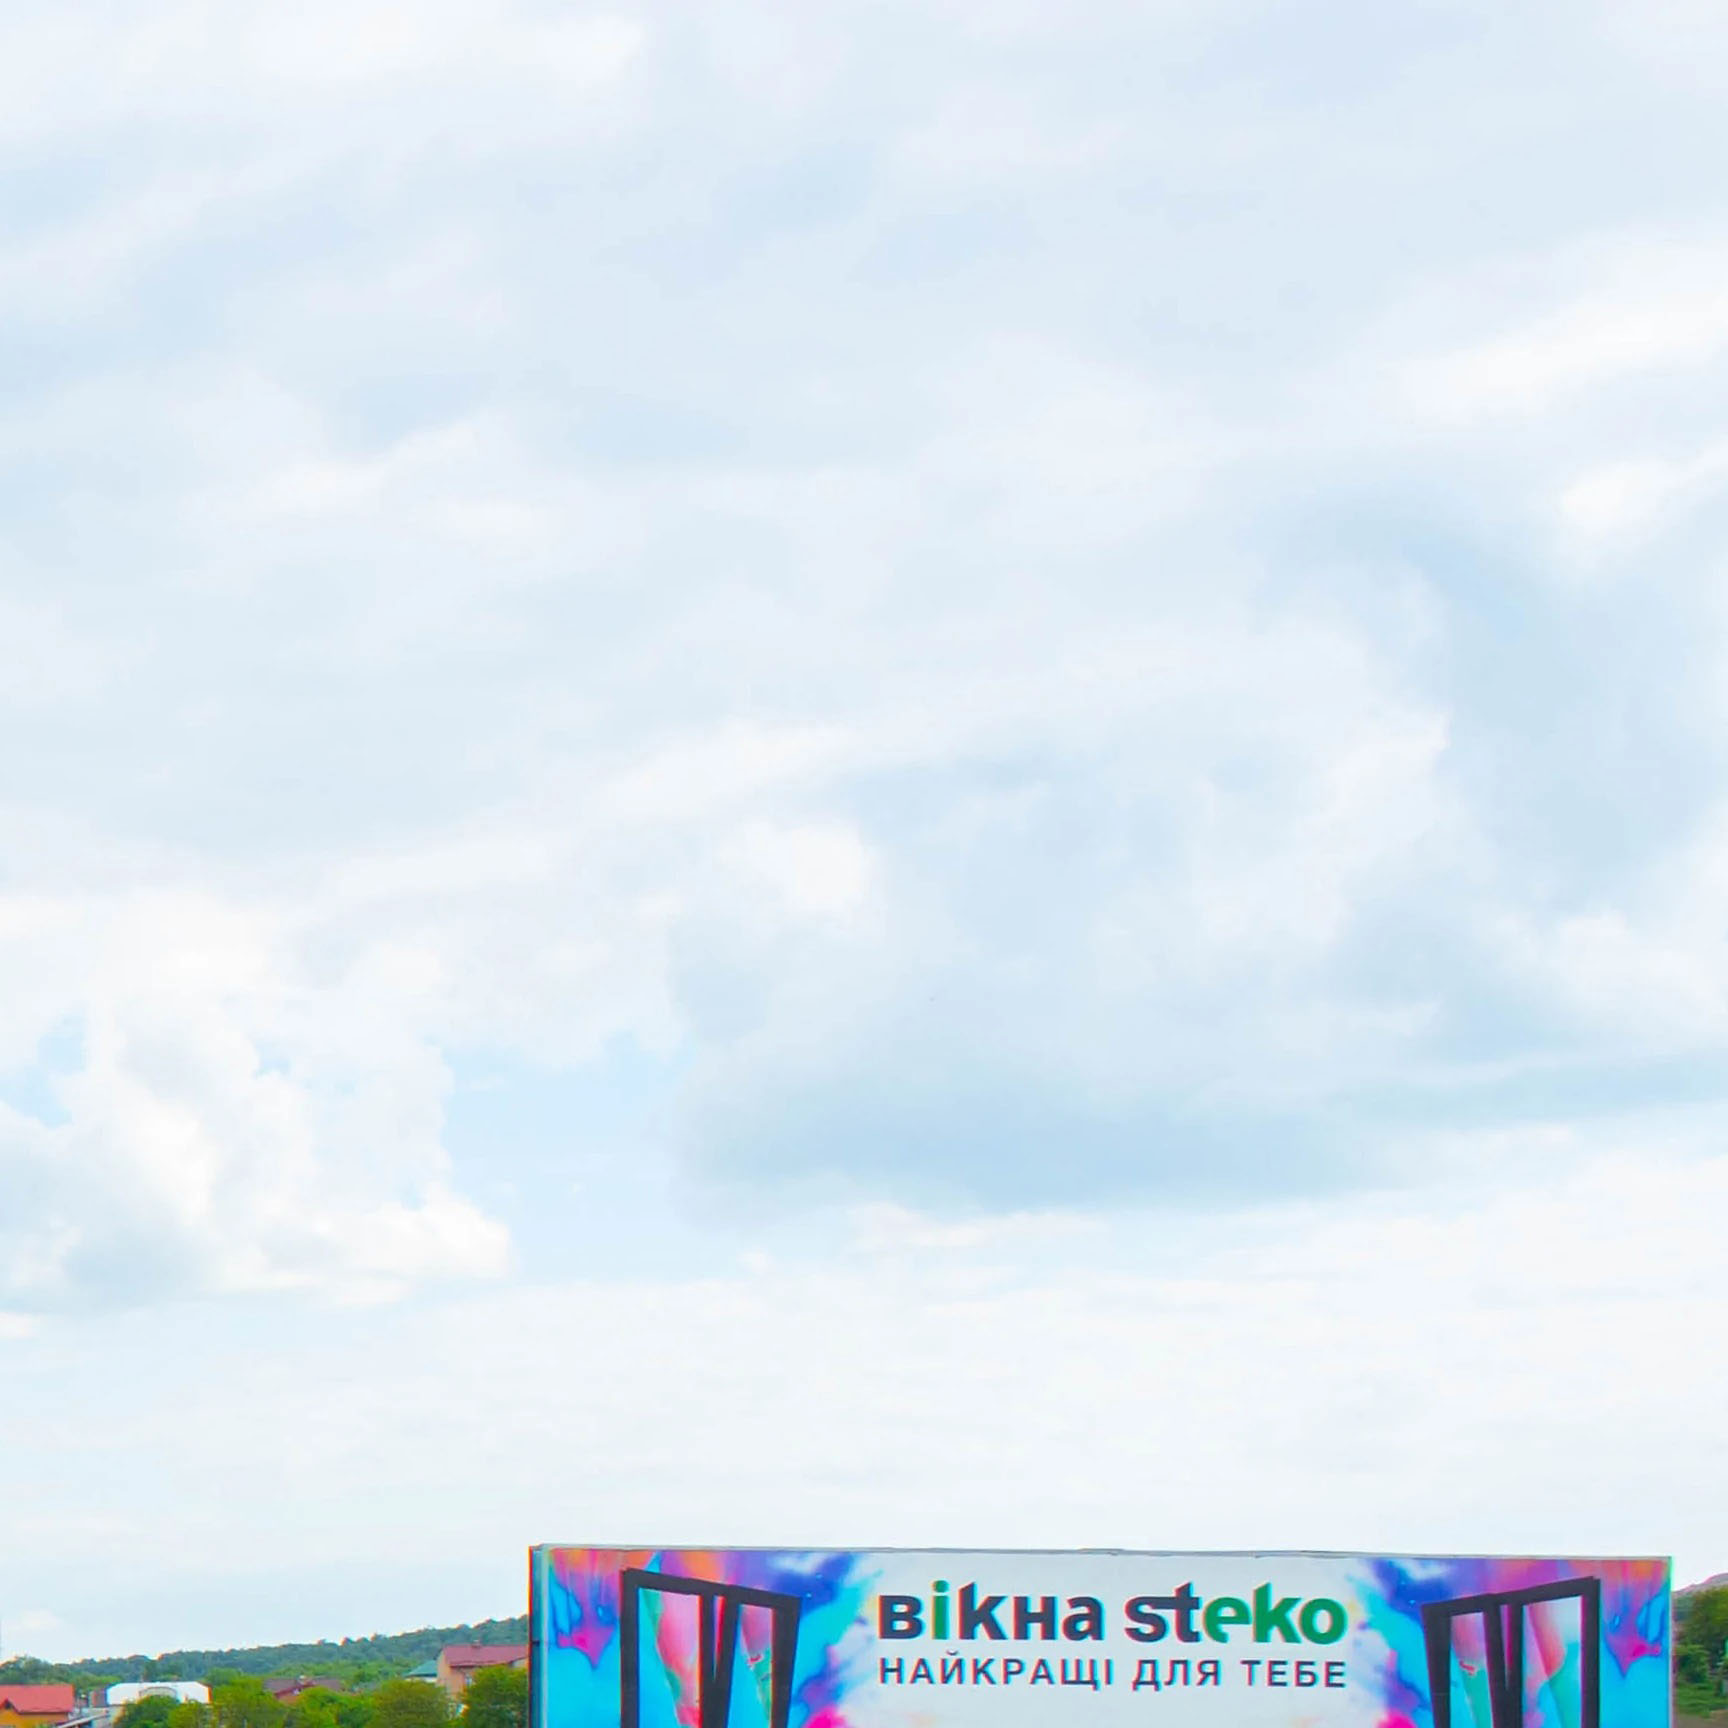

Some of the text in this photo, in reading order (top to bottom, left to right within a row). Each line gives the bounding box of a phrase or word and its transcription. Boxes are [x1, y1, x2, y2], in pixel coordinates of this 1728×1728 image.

[1124, 1582, 1348, 1644] steko
[878, 1650, 1346, 1692] НАЙКРАЩІ ДЛЯ ТЕБЕ
